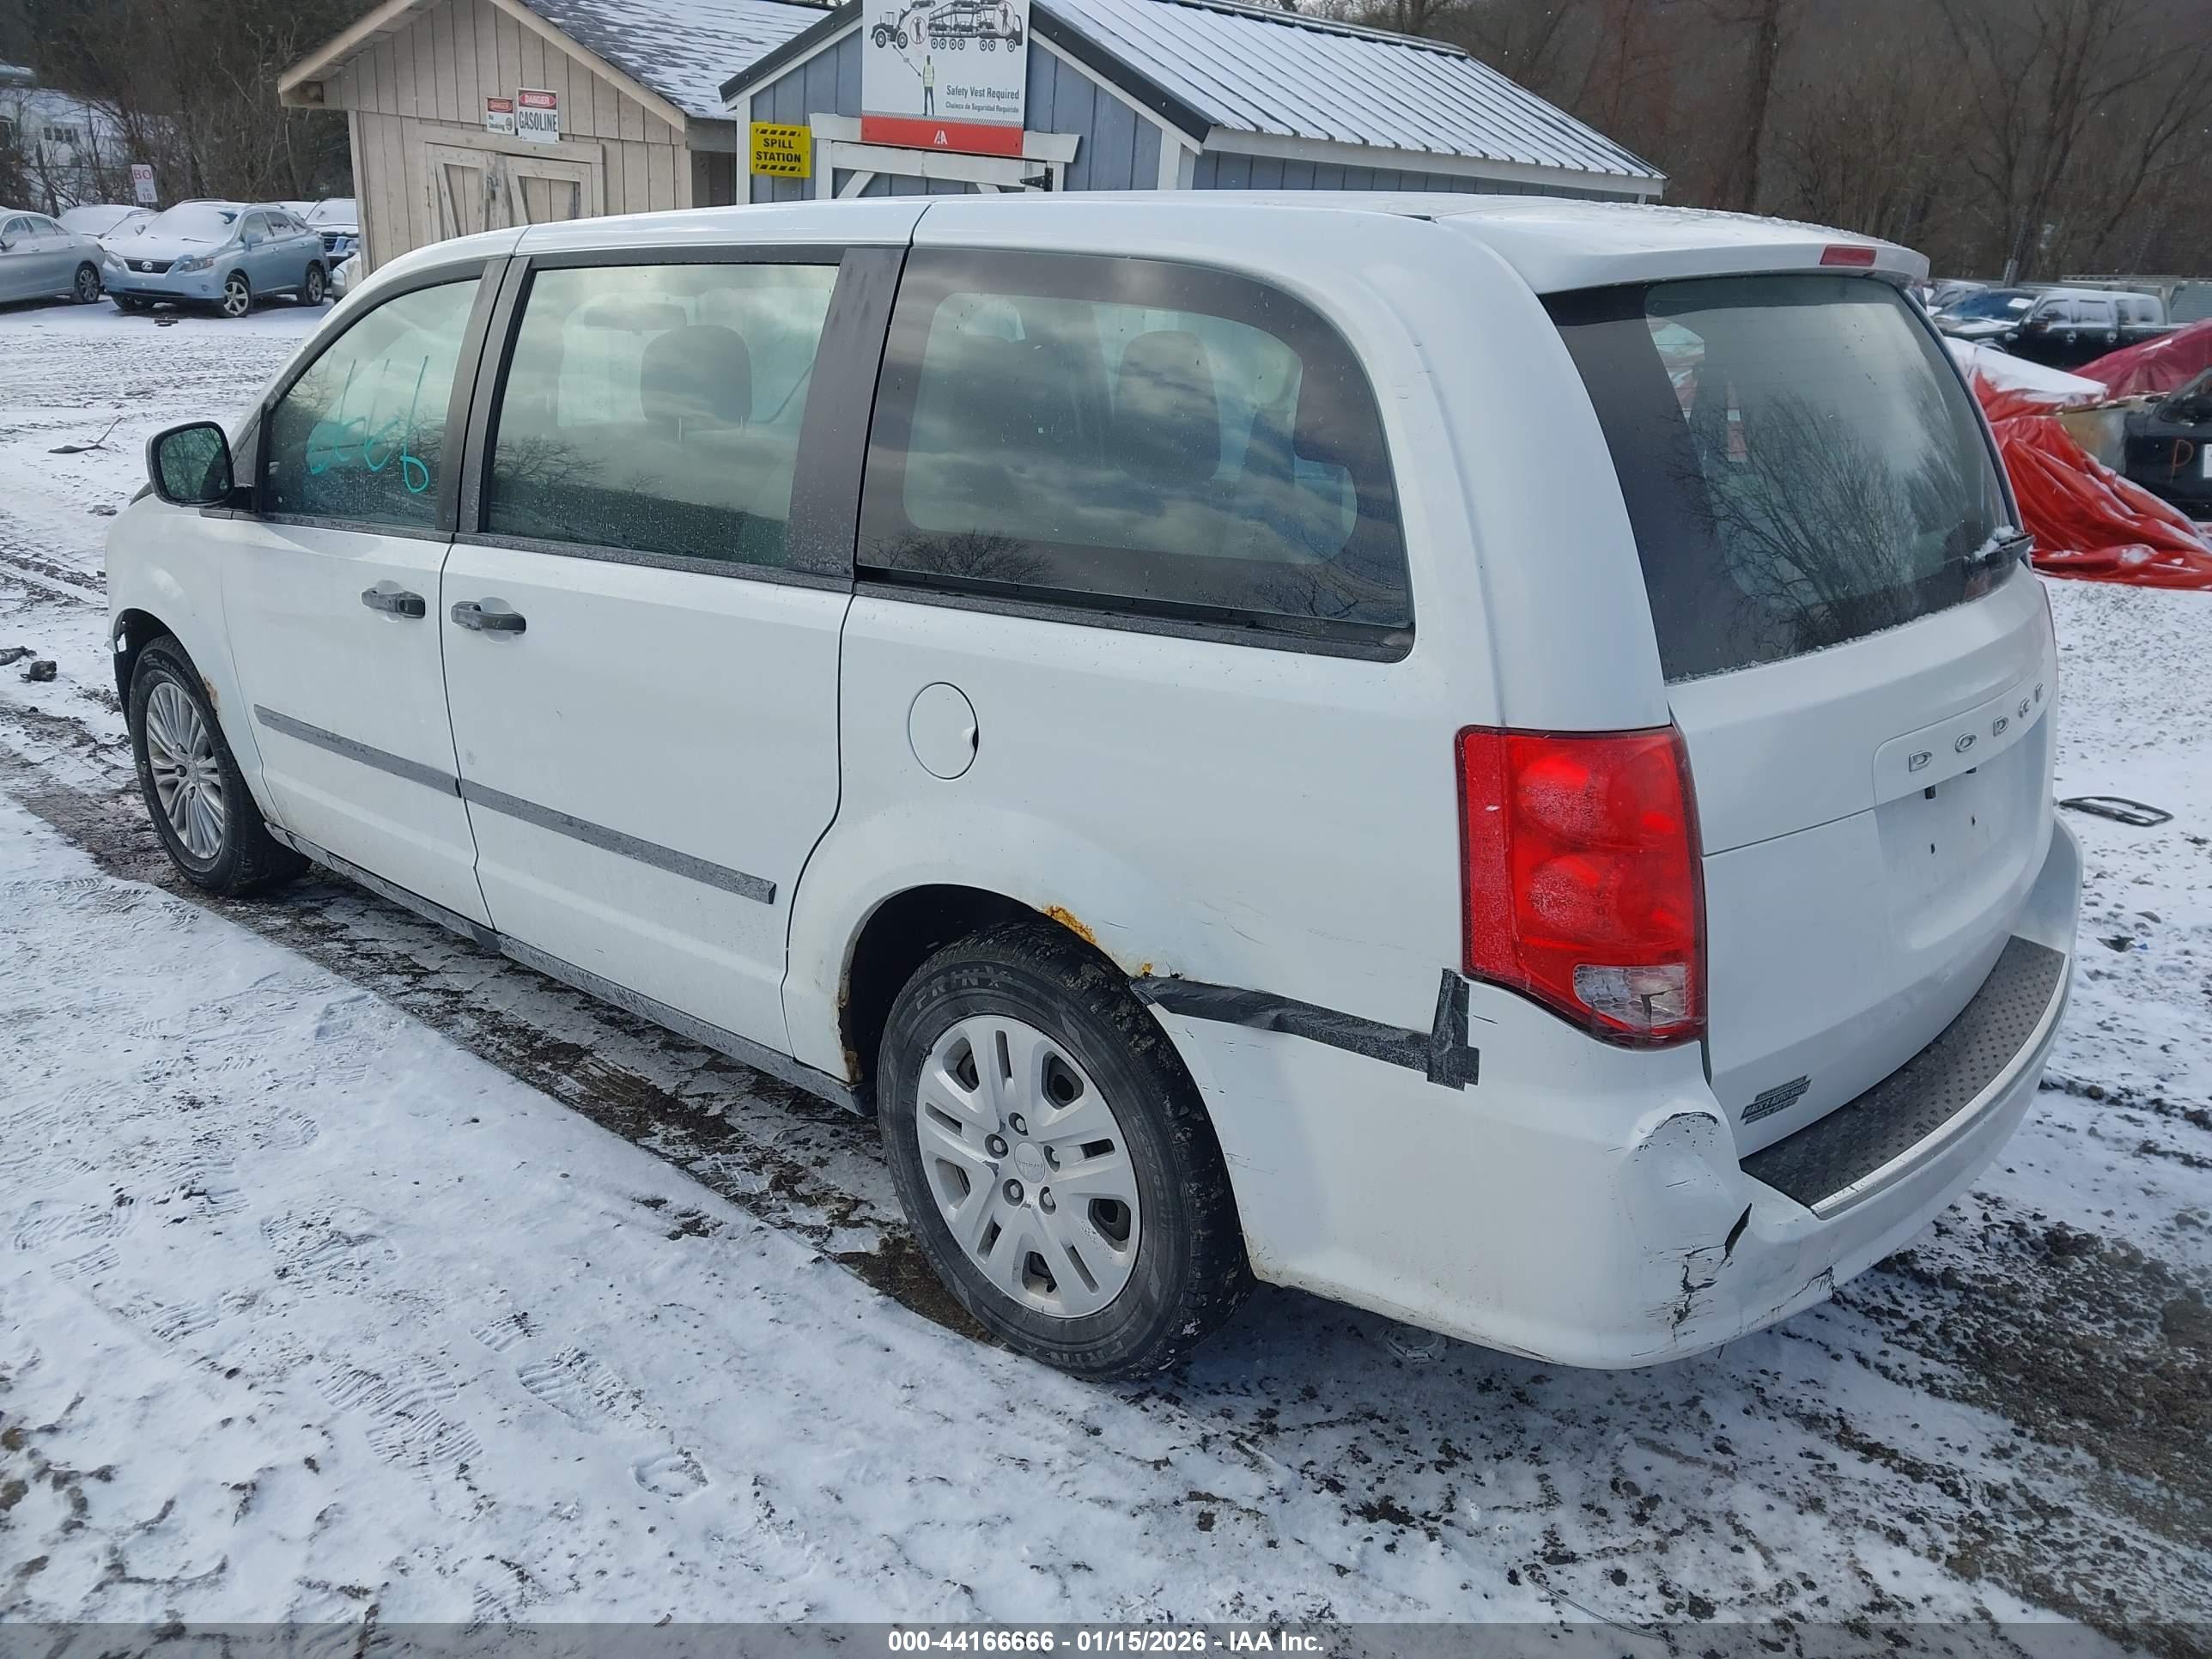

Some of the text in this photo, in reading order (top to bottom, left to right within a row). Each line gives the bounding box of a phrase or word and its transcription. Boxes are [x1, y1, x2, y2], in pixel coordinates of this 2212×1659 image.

[524, 94, 550, 104] DANGER
[946, 84, 1019, 101] Safety Vest Required
[519, 111, 557, 132] GASOLINE
[763, 137, 794, 149] SPILL
[756, 150, 801, 163] STATION
